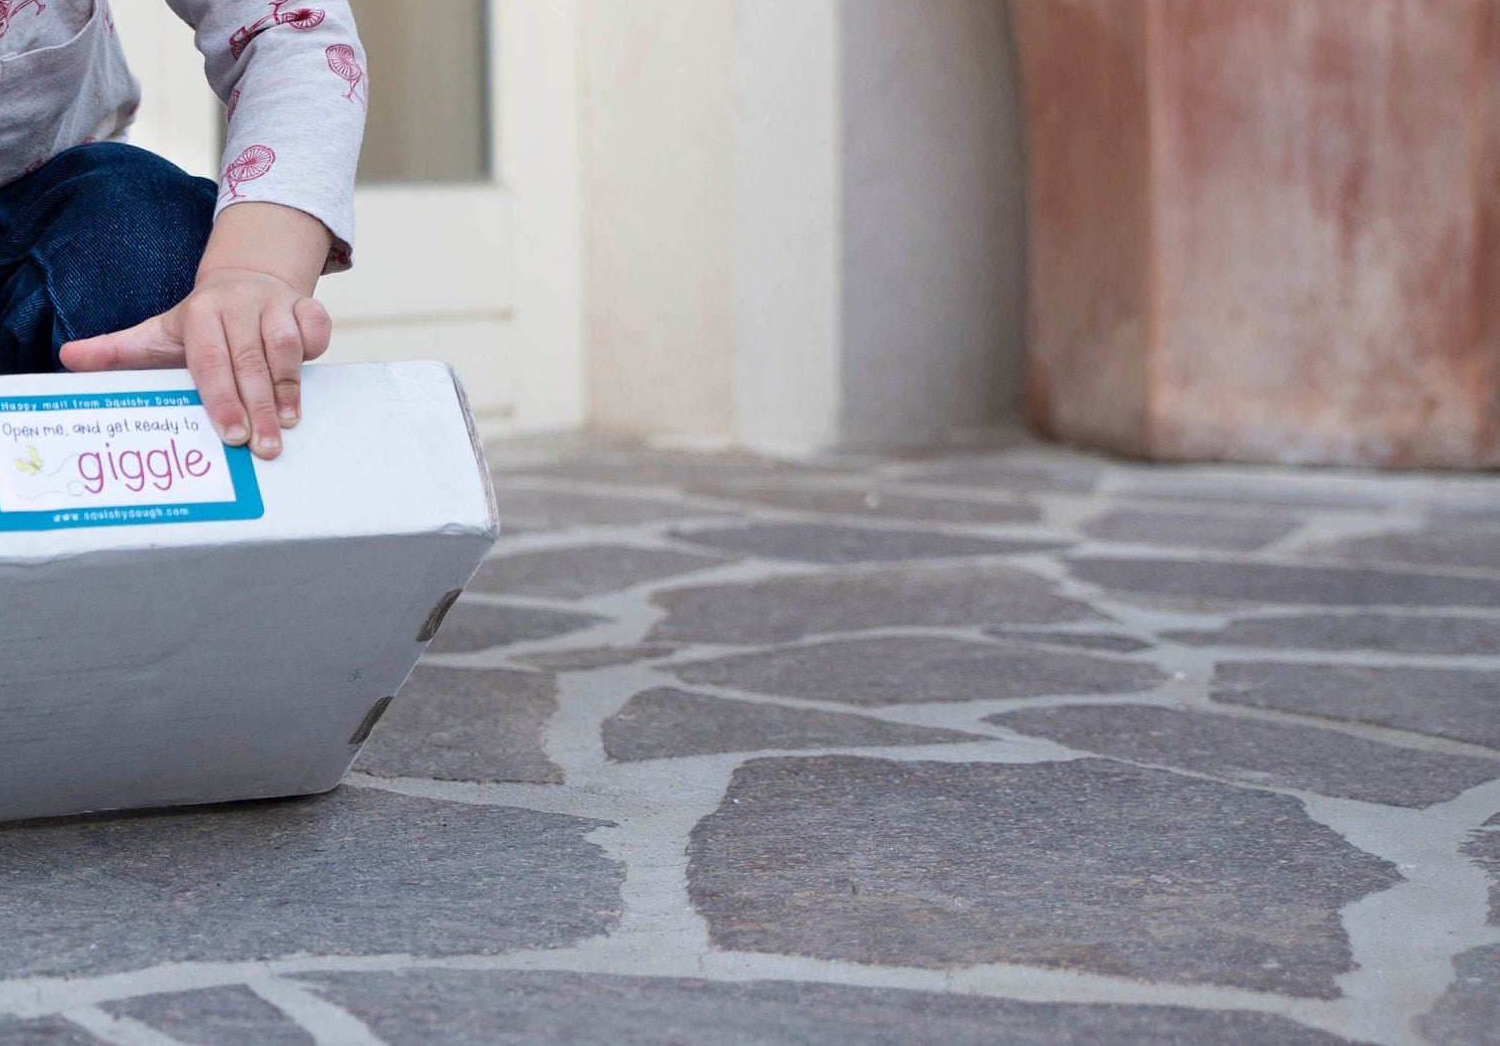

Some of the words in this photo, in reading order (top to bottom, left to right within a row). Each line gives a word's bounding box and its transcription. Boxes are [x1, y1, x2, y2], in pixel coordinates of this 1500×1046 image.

[1, 402, 37, 411] Happy
[43, 400, 68, 410] mail
[72, 399, 100, 410] from
[105, 397, 149, 407] Squishy
[155, 396, 190, 406] Dough
[106, 418, 130, 438] get
[184, 416, 199, 431] to
[78, 438, 211, 494] giggle
